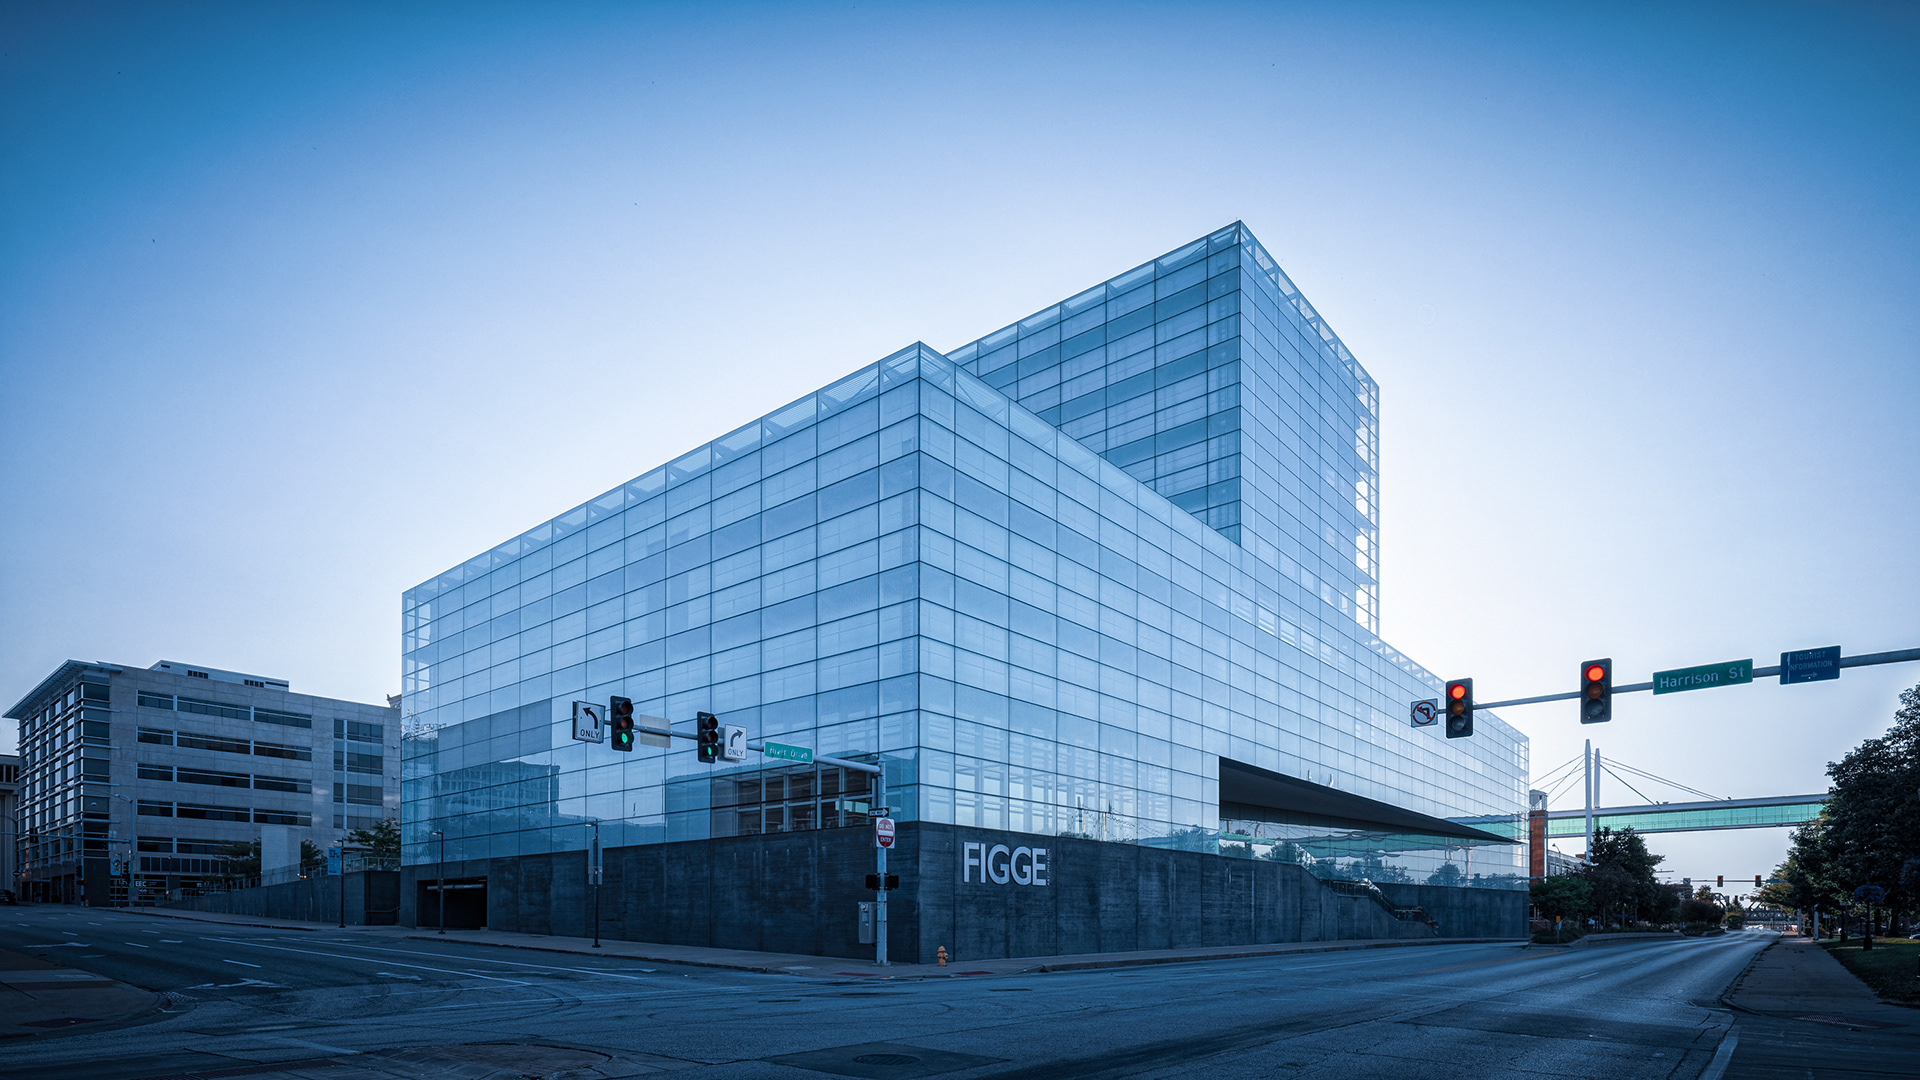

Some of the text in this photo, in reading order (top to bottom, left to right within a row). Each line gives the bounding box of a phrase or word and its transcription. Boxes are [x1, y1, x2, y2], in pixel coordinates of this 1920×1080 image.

[1795, 650, 1826, 661] TOURIST
[1660, 666, 1745, 689] Harrison St
[580, 728, 600, 739] ONLY
[727, 748, 744, 757] ONLY
[964, 842, 1046, 886] FIGGE
